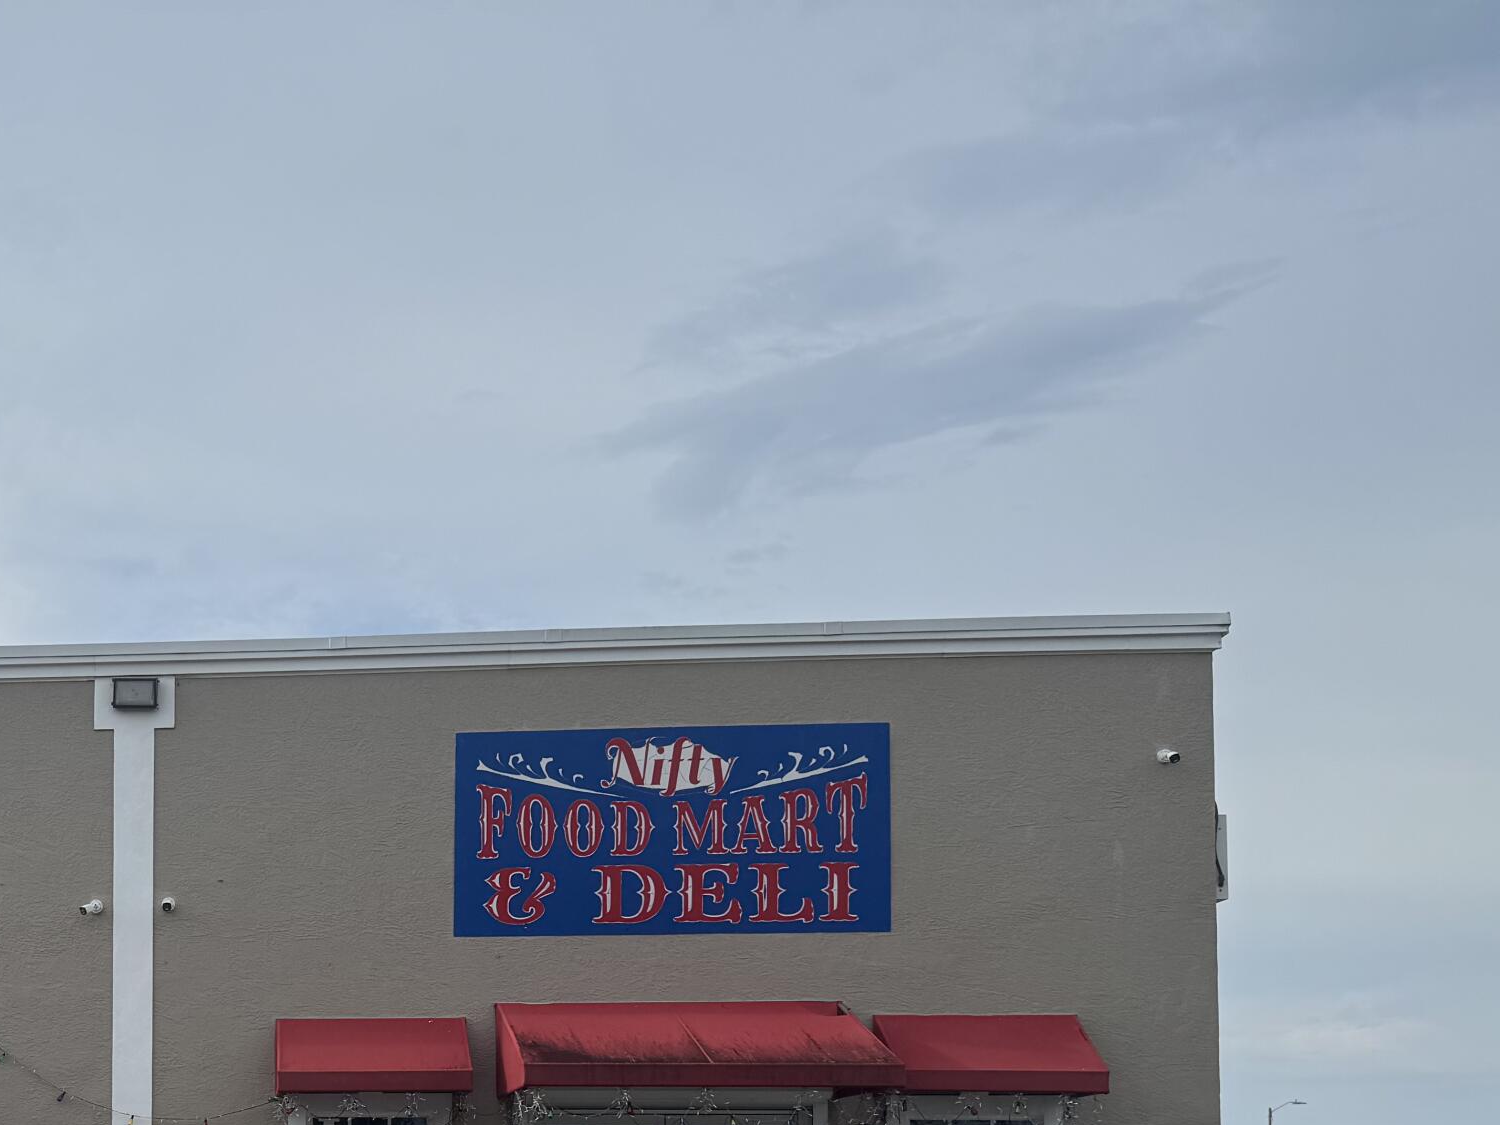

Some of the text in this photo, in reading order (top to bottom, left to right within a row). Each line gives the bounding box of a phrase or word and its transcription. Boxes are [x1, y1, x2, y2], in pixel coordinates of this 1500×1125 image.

[601, 737, 739, 796] Nifty
[476, 772, 868, 859] FOOD MART
[483, 862, 860, 925] & DELI
